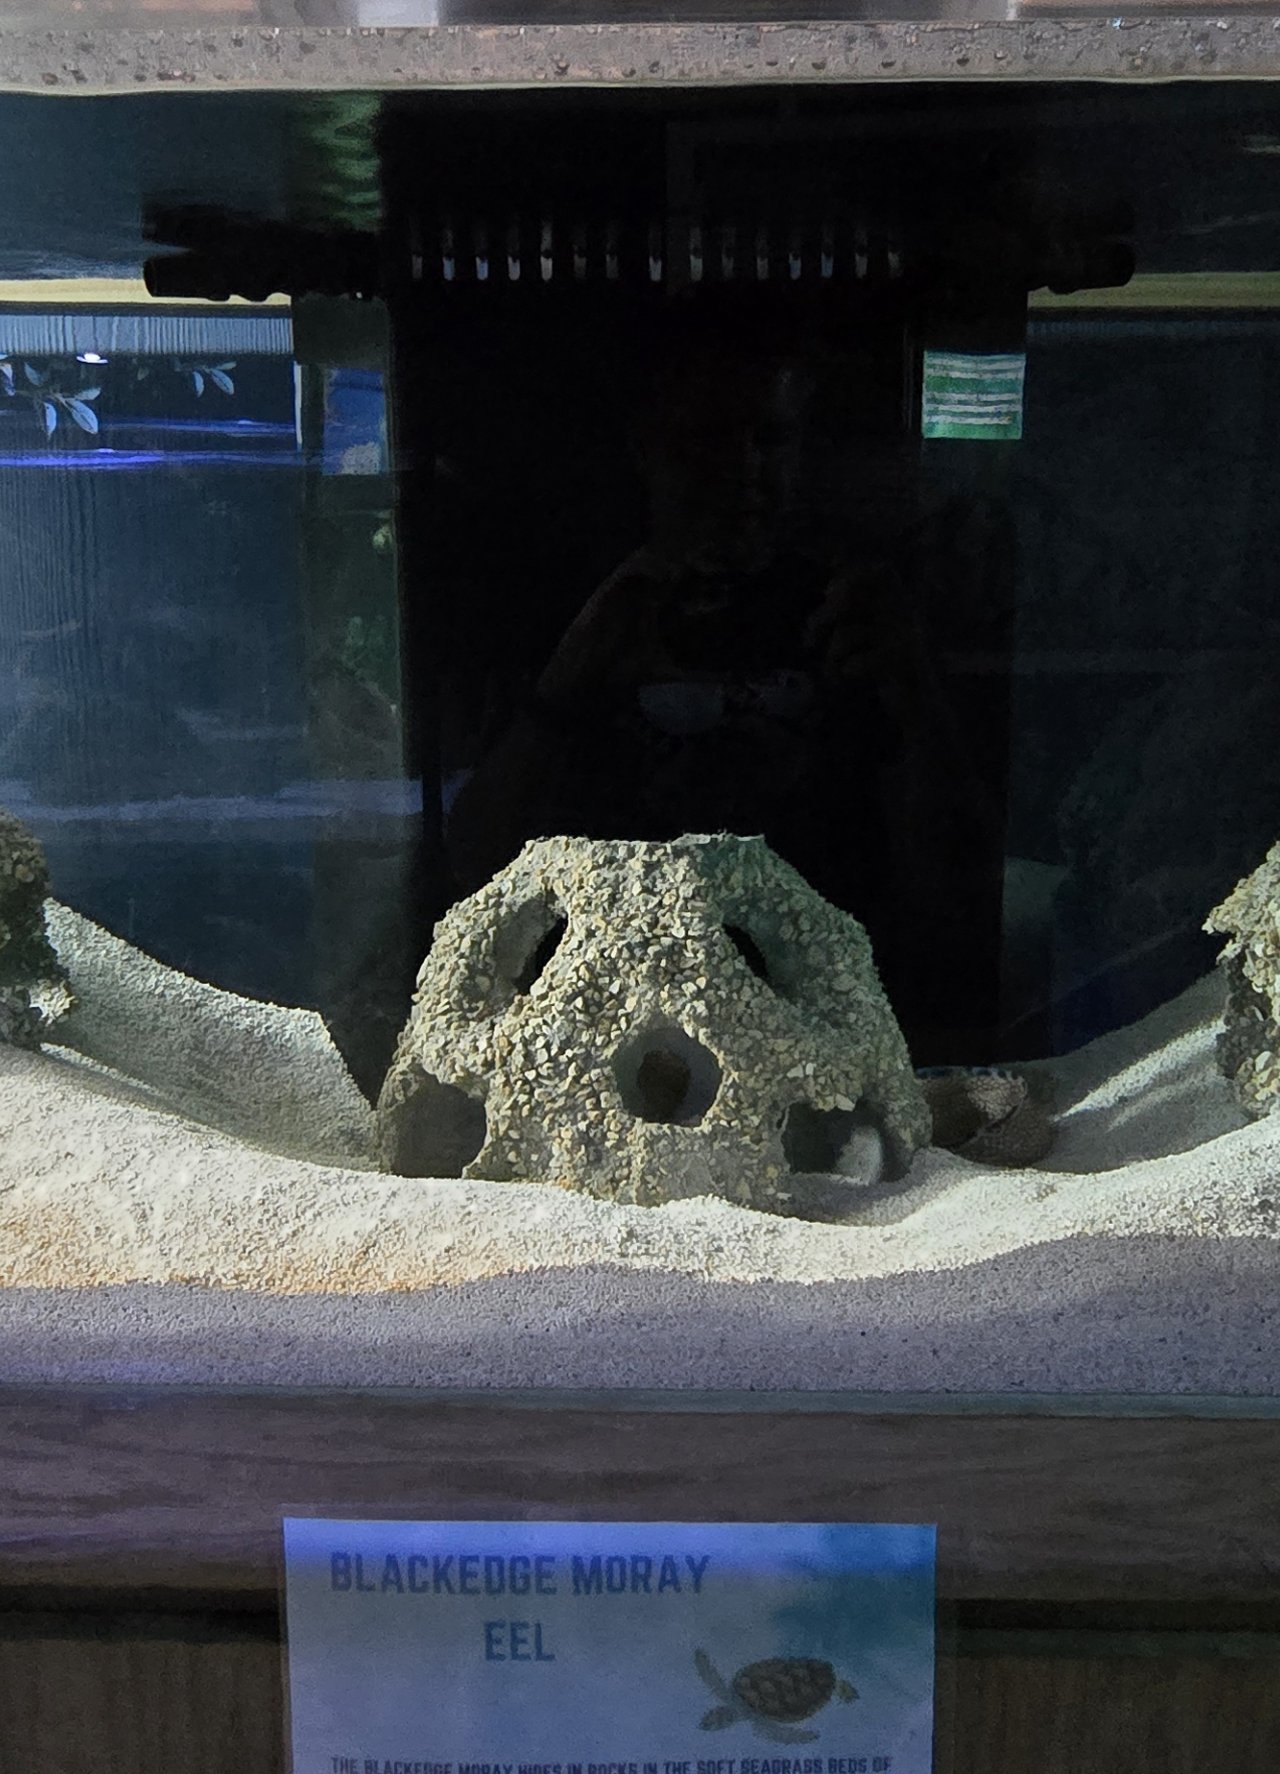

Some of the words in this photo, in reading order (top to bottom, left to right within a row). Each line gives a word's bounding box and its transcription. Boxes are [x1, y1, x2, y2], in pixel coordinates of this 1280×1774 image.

[331, 1552, 557, 1596] BLACKEDGE
[571, 1553, 711, 1594] MORAY
[483, 1620, 556, 1662] EEL
[331, 1757, 358, 1774] THE
[364, 1760, 453, 1774] BLACKEDGE
[458, 1762, 513, 1774] MORAY
[663, 1761, 692, 1774] THE
[697, 1760, 735, 1774] SOFT
[740, 1758, 823, 1774] SEAGRASS
[828, 1757, 867, 1774] BEDS
[872, 1756, 893, 1774] OF
